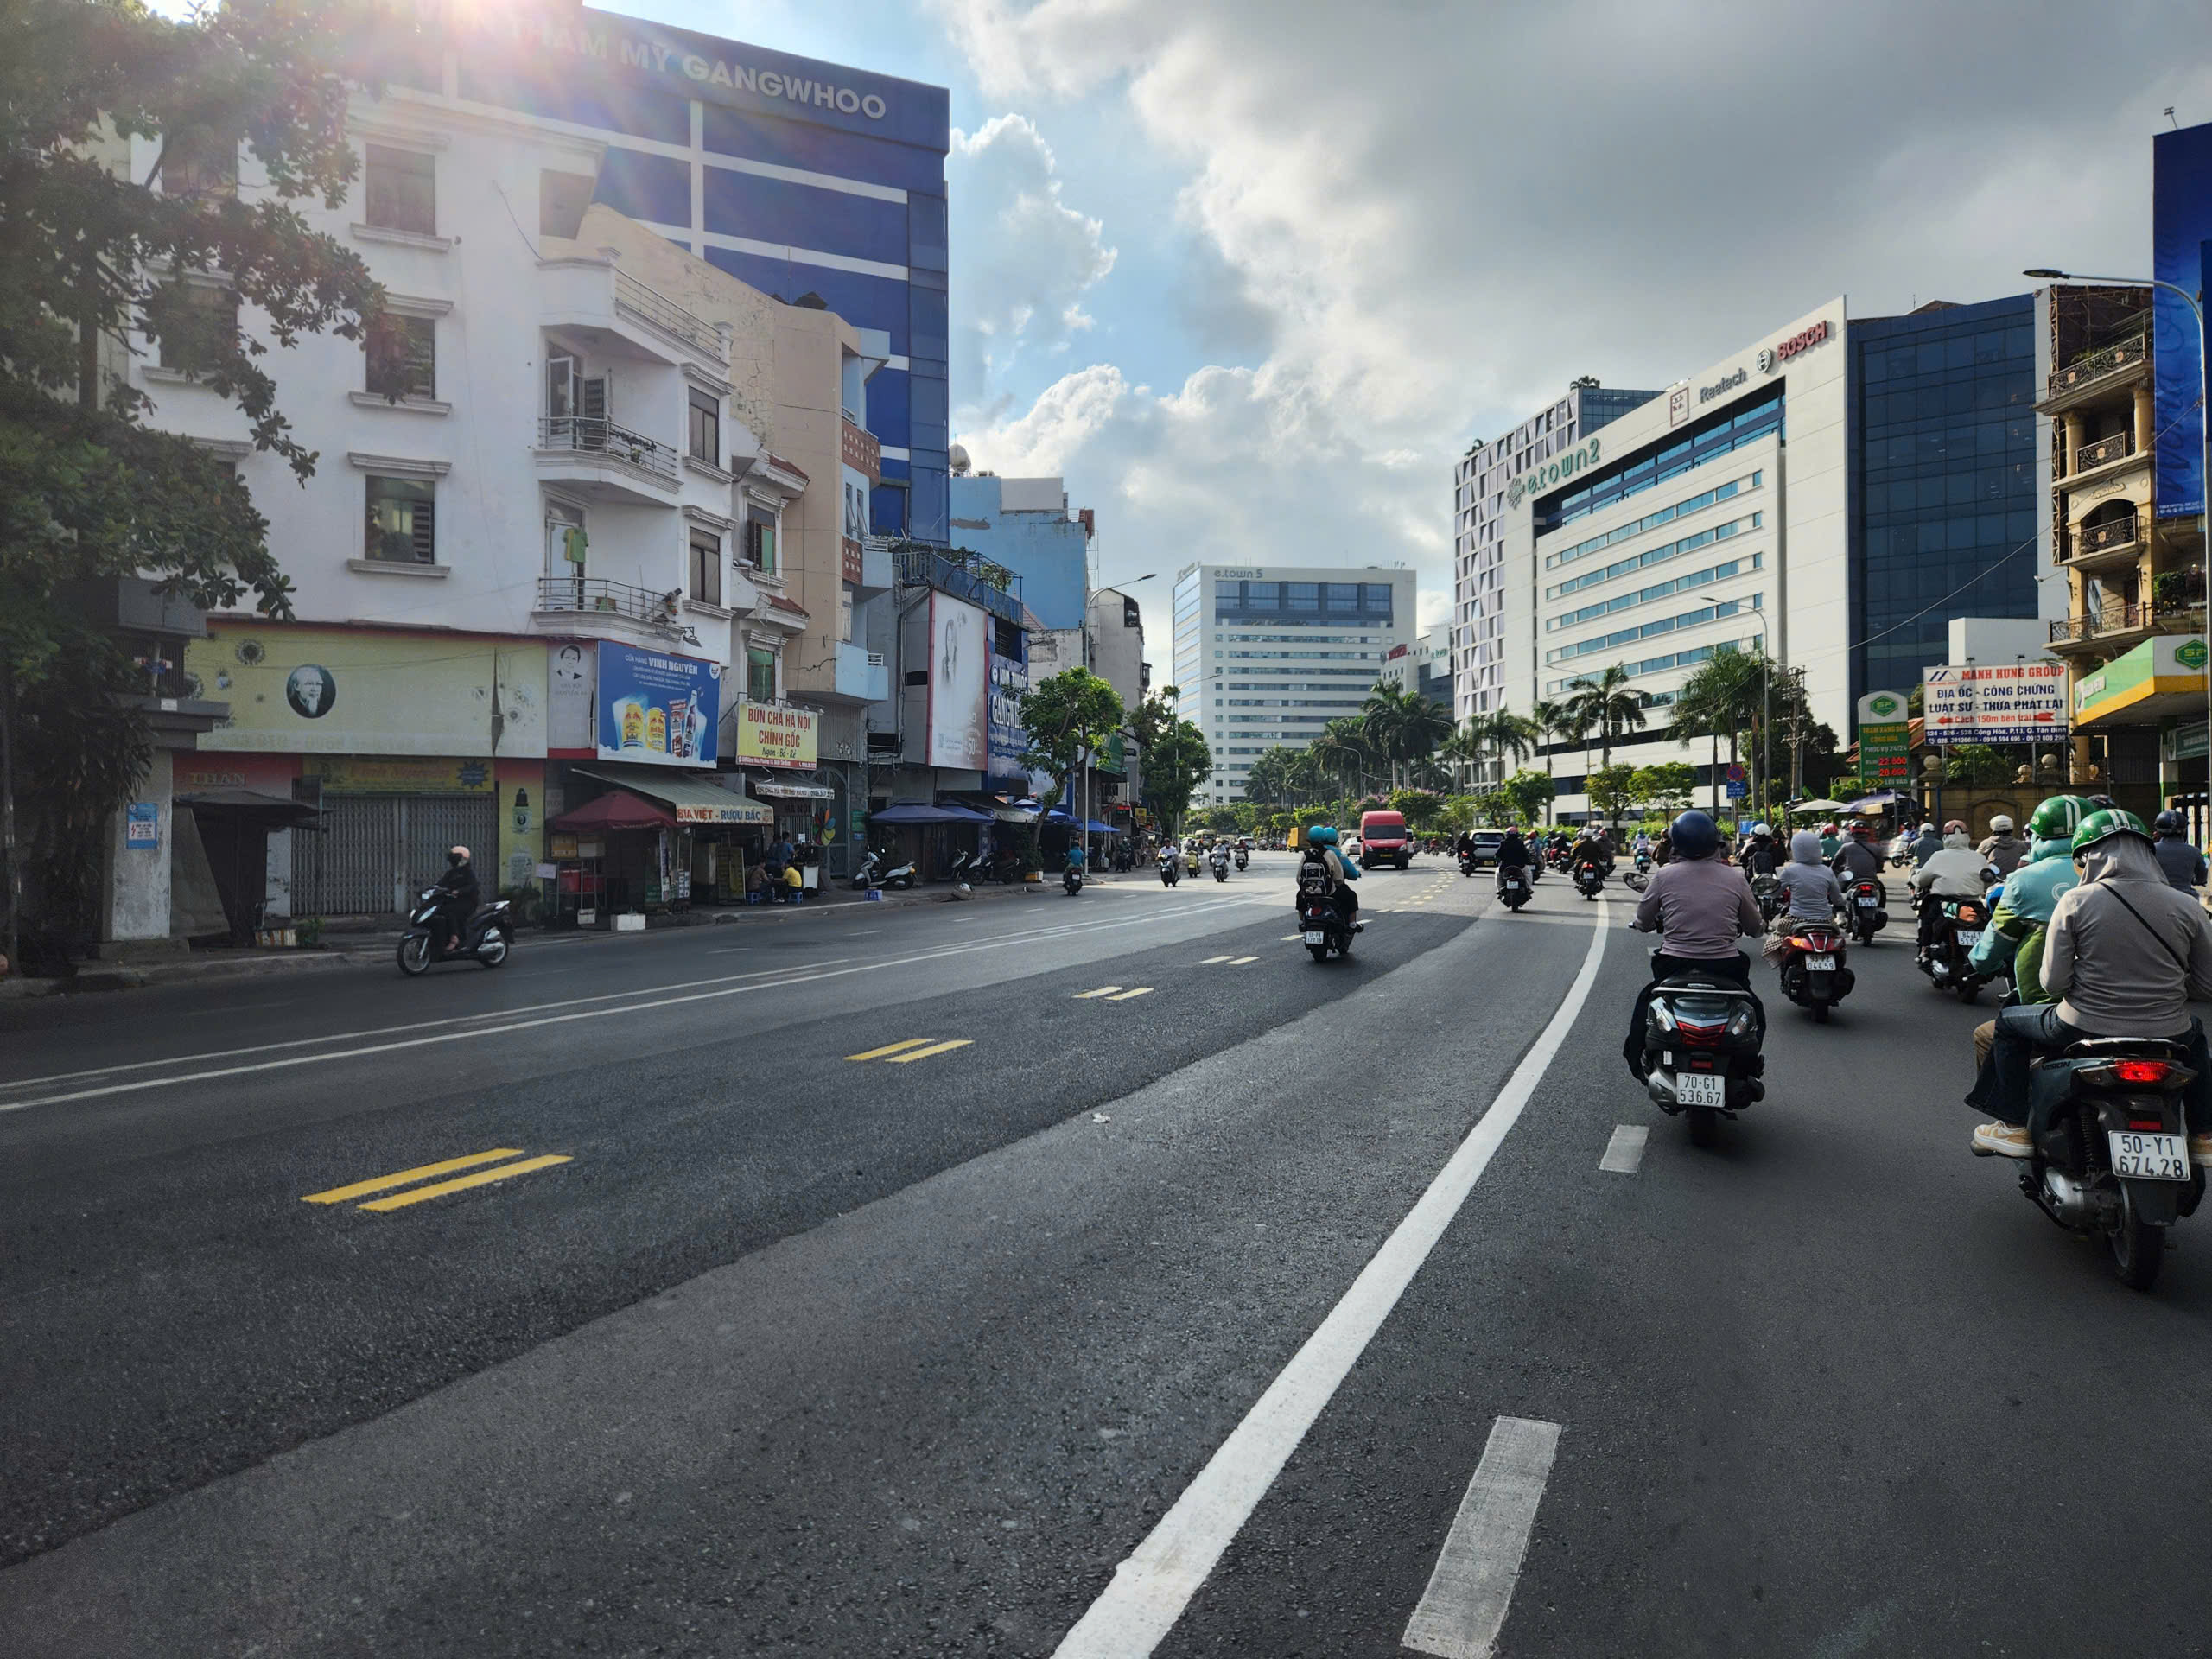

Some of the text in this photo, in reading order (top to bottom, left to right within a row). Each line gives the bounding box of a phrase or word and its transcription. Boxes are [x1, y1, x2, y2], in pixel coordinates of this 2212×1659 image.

[682, 54, 887, 119] GANGWHOO
[1777, 320, 1827, 362] BOSCH
[1700, 367, 1747, 404] Reetech
[1213, 569, 1263, 578] e.town 5
[648, 656, 668, 671] VINH
[2028, 665, 2065, 679] GROUP
[1937, 689, 1955, 702] ĐỊA
[1958, 683, 1973, 698] ỐC
[1983, 685, 2013, 697] CÔNG
[2017, 683, 2055, 696] CHỨNG
[747, 706, 766, 724] BÚN
[785, 711, 796, 728] HÀ
[798, 713, 810, 734] NỘI
[1976, 715, 1999, 723] 150m
[759, 728, 801, 748] CHÍNH GỐC
[762, 746, 776, 758] Ngon
[677, 808, 692, 819] BIA
[693, 807, 712, 821] VIỆT
[2041, 1060, 2072, 1071] VISION
[1684, 1075, 1716, 1090] 70-G1
[1680, 1089, 1722, 1105] 536.67
[2120, 1135, 2174, 1156] 50-Y1
[2119, 1155, 2183, 1178] 674.28
